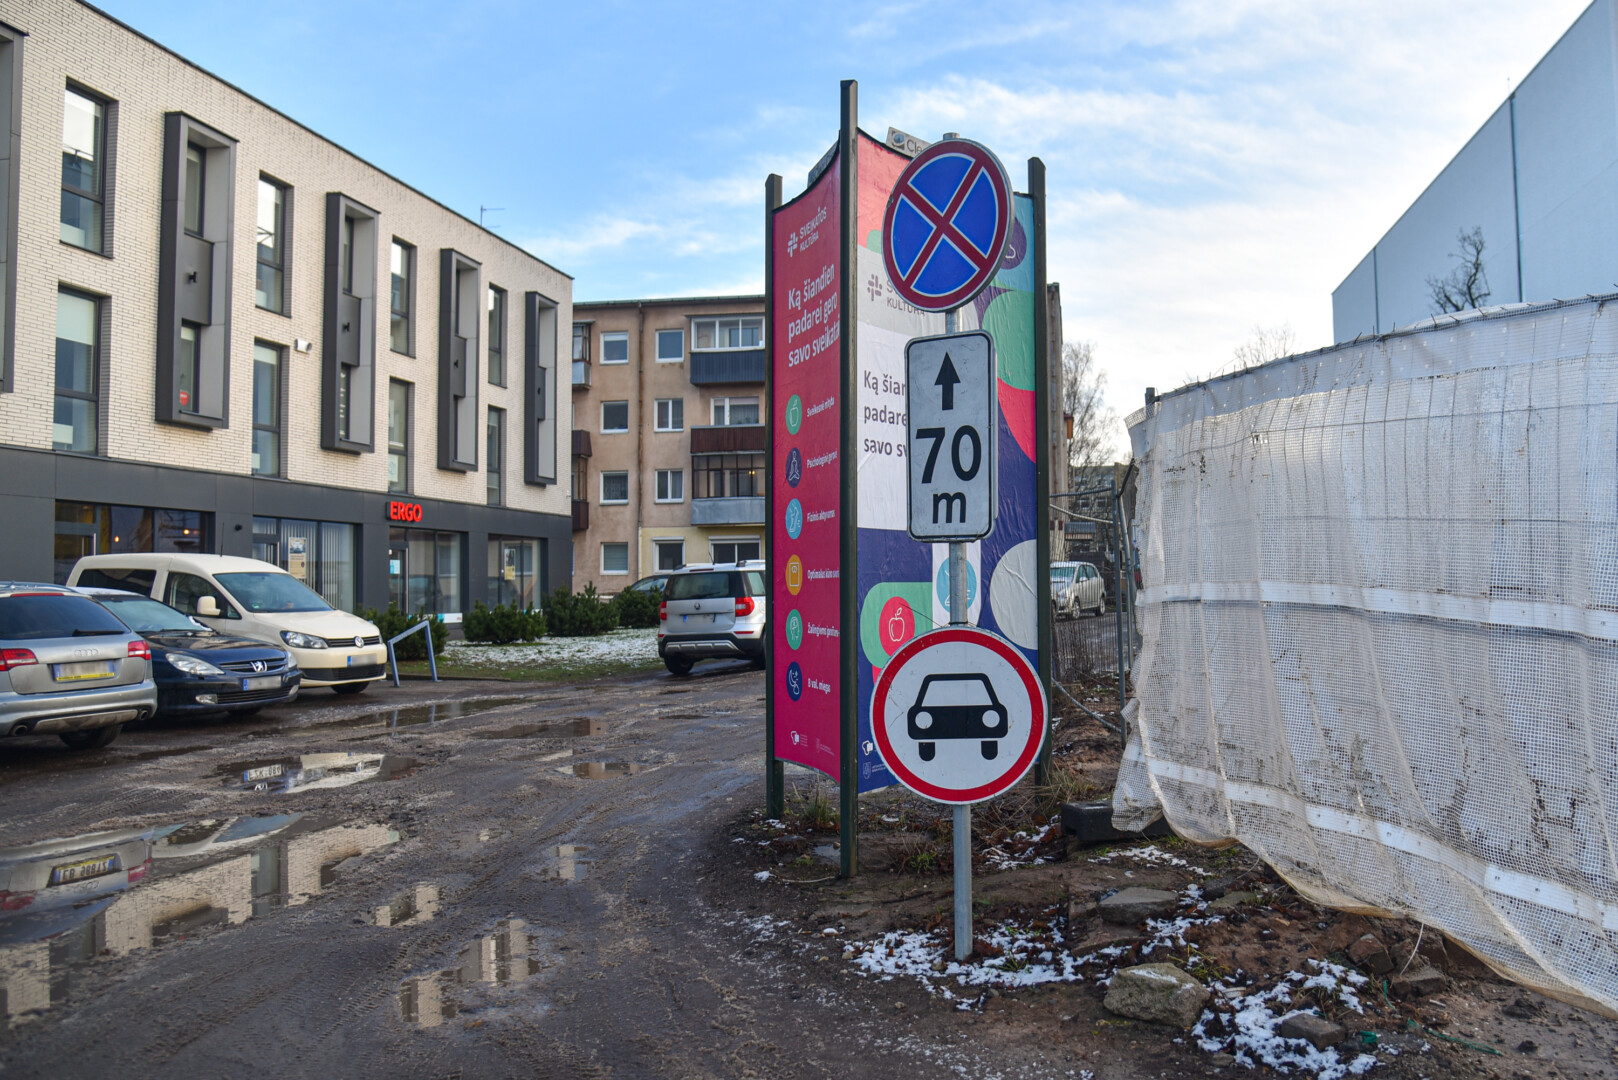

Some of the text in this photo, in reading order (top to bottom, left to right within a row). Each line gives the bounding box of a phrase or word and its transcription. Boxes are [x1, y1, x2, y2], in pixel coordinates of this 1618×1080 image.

[799, 205, 827, 240] SVEIKATOS
[788, 263, 835, 311] Ką šiandien
[788, 291, 838, 344] padarei gero
[788, 313, 840, 368] savo sveikatai
[864, 369, 879, 396] Ką
[864, 438, 893, 456] savo
[915, 424, 982, 484] 70
[390, 500, 423, 522] ERGO
[932, 491, 967, 524] m
